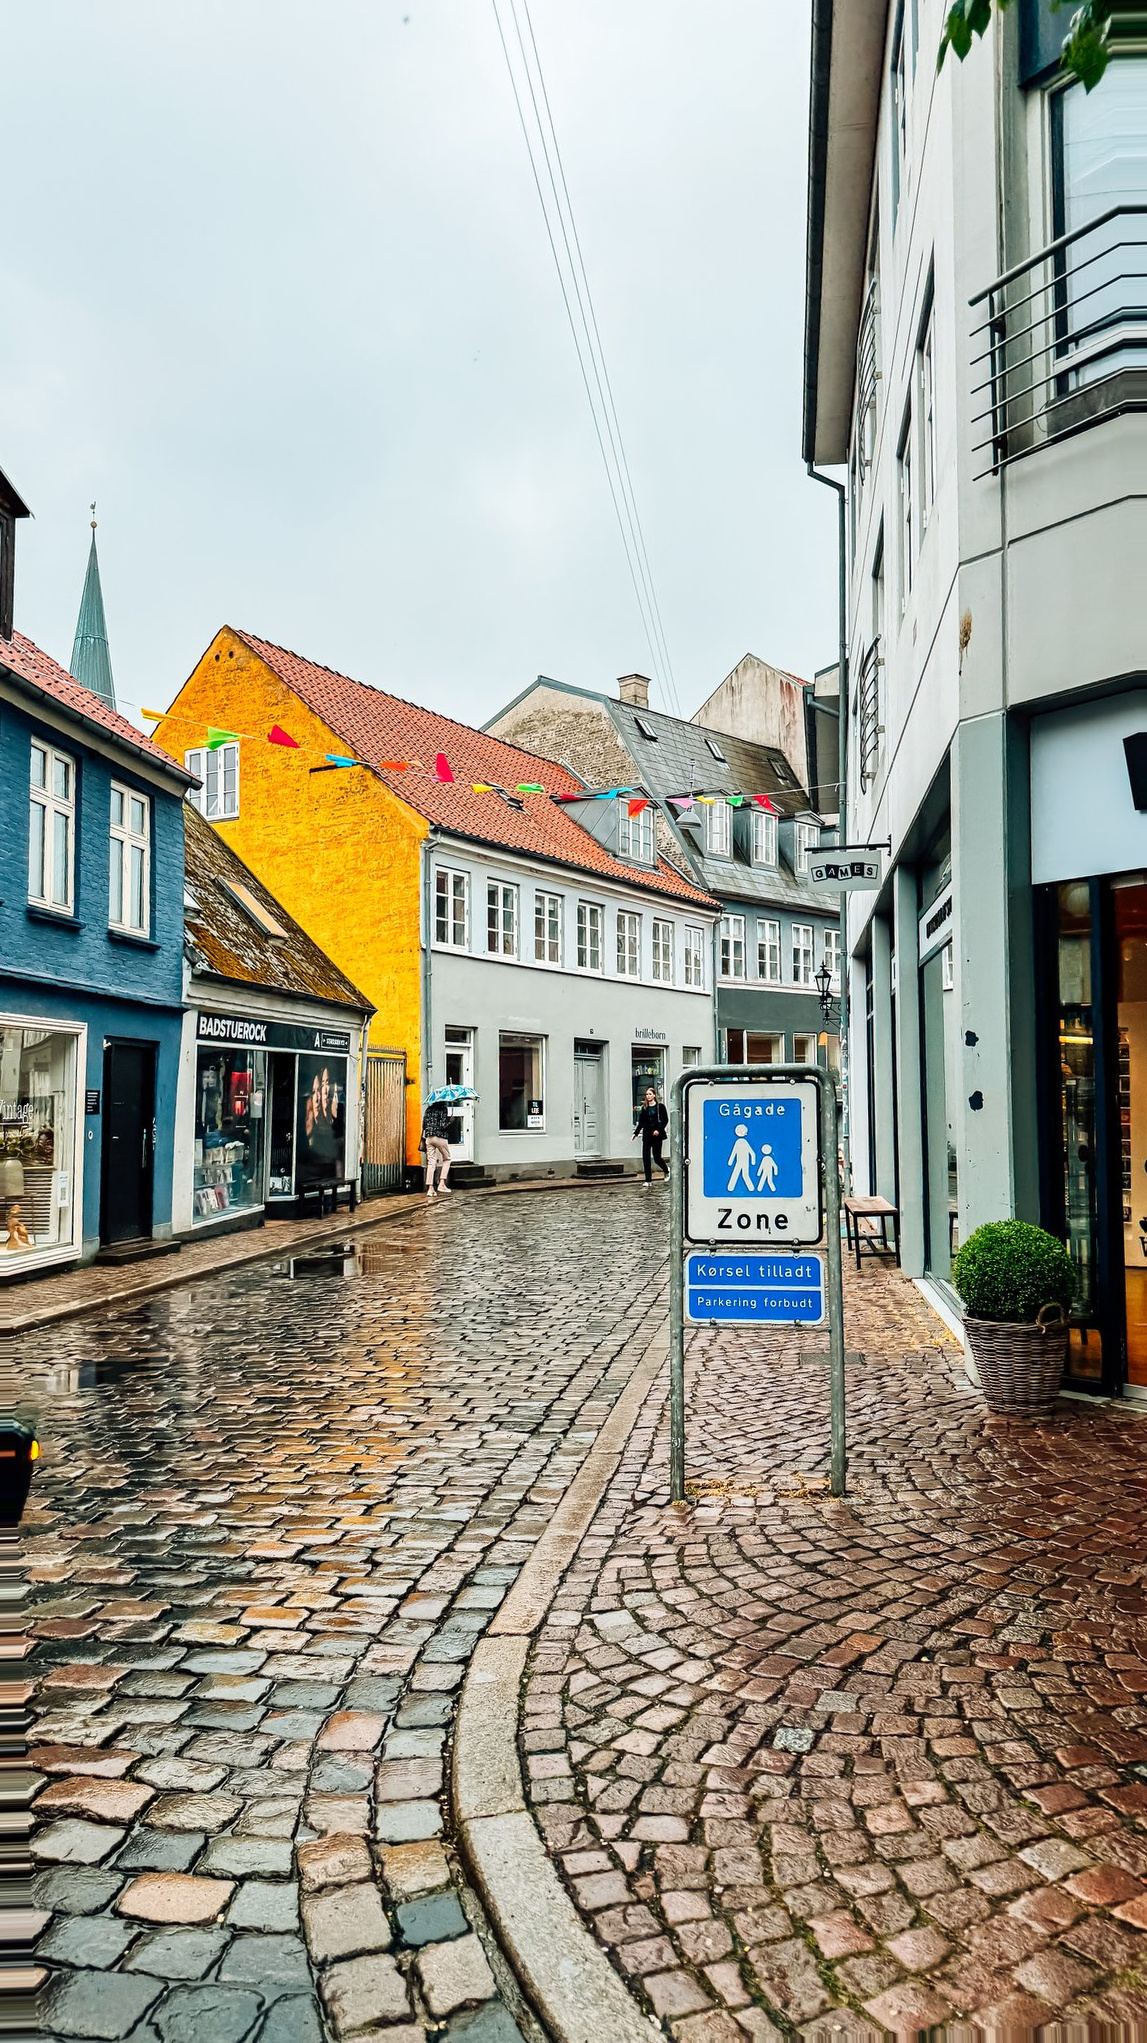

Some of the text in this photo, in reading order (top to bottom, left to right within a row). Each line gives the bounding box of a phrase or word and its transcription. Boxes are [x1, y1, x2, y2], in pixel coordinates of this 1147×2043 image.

[814, 864, 874, 879] GAMES
[199, 1016, 267, 1042] BADSTUEROCK
[719, 1102, 786, 1119] Gågade
[717, 1208, 789, 1231] Zone
[696, 1264, 812, 1278] Kørsel tilladt
[697, 1296, 813, 1309] Parkering forbudt
